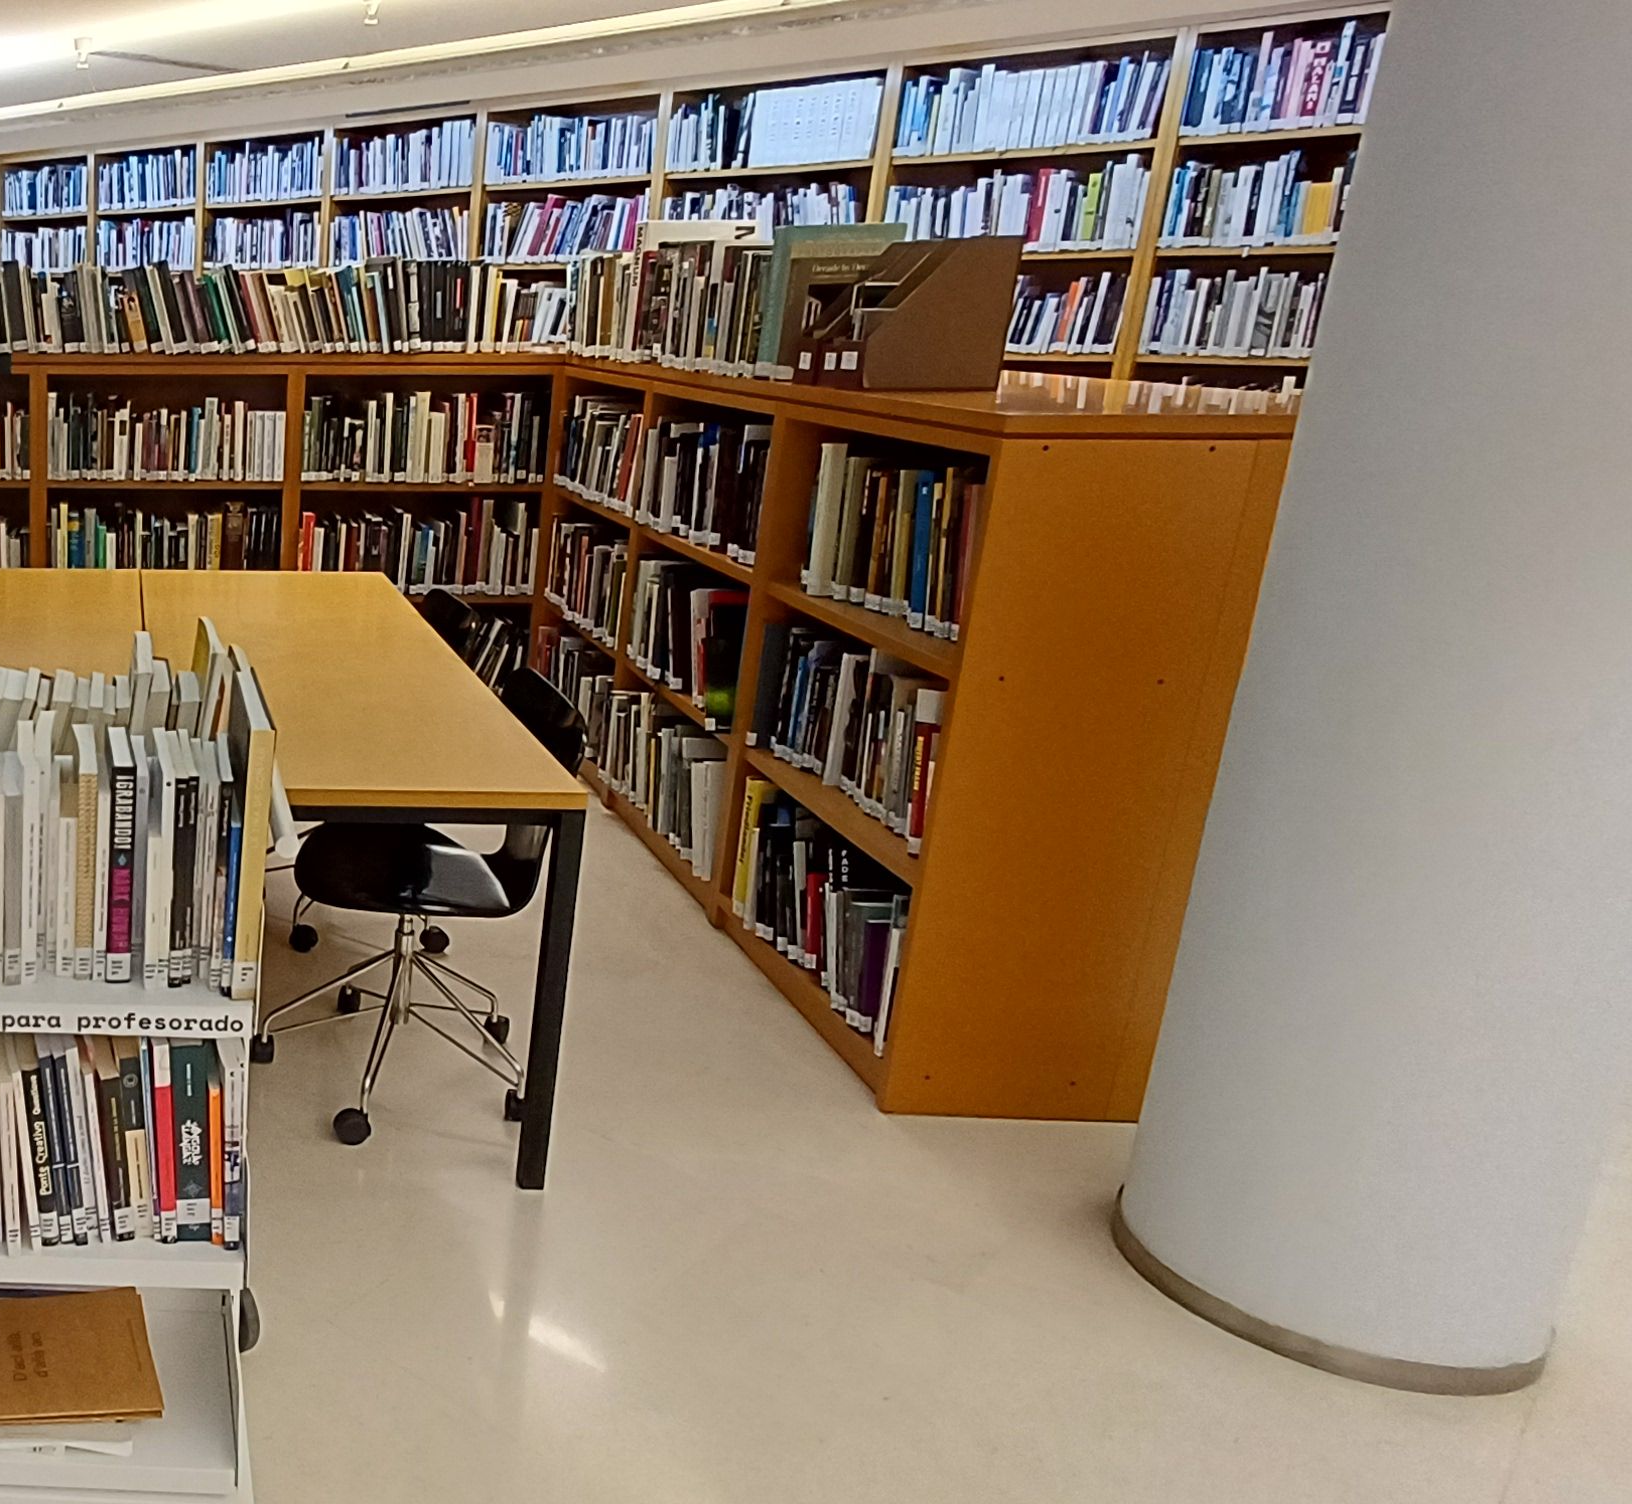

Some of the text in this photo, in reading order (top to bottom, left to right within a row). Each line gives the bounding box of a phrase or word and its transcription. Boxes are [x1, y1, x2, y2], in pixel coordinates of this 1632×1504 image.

[632, 226, 644, 287] MAGNUM
[110, 907, 131, 950] HOWAR
[1, 1012, 61, 1031] para
[77, 1012, 244, 1033] profesorado
[32, 1121, 48, 1164] Creativo
[39, 1165, 52, 1196] Ponte
